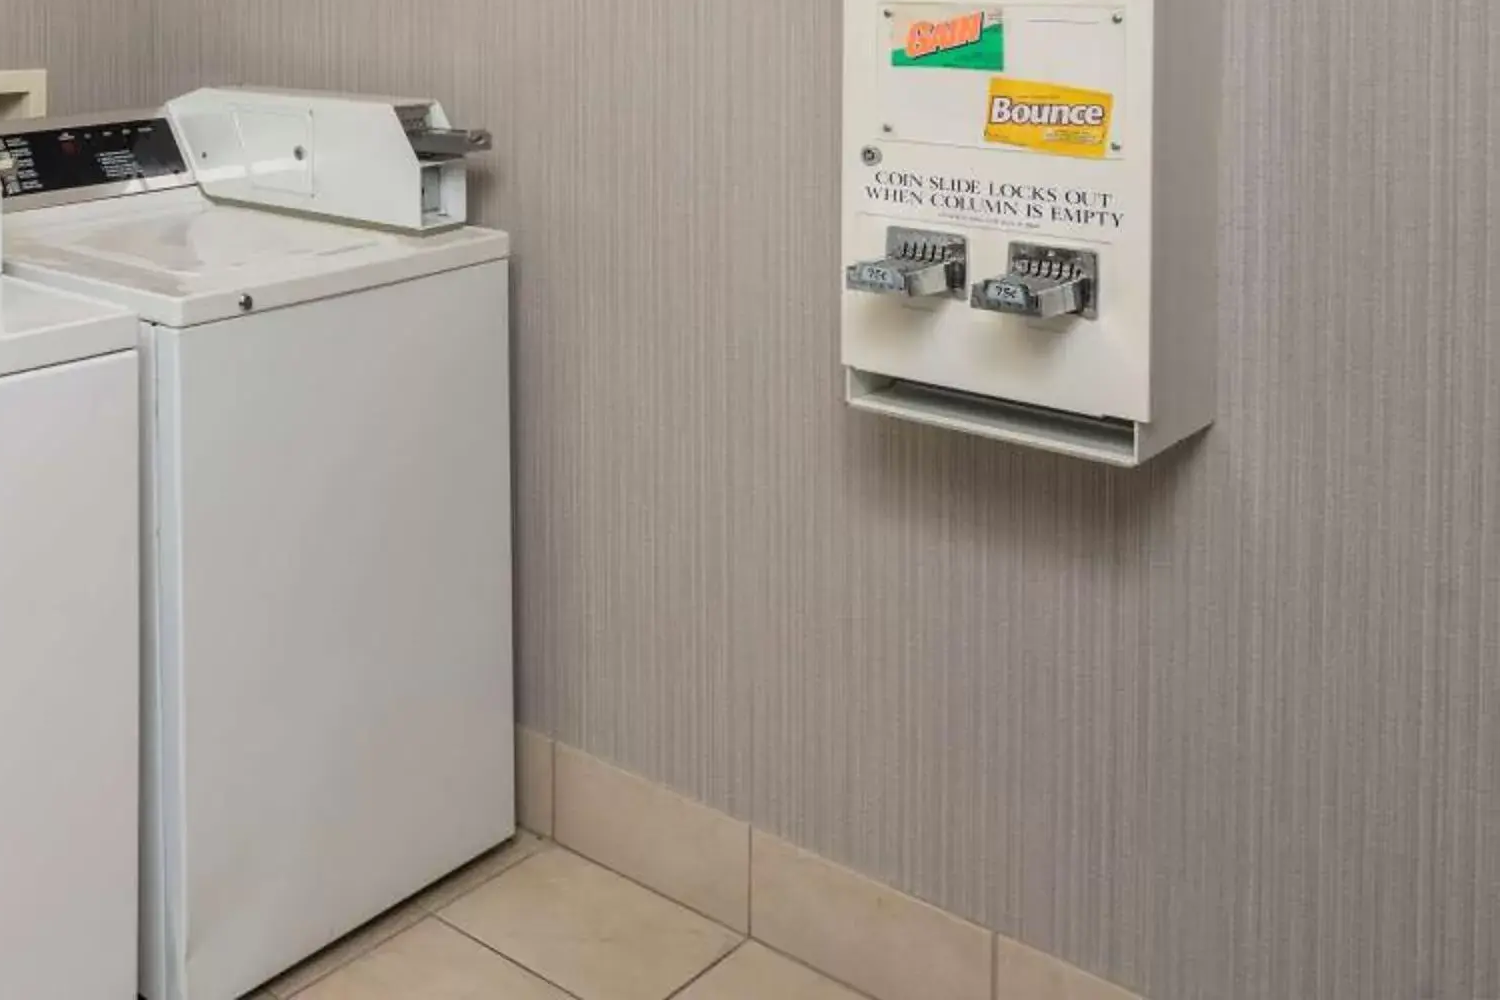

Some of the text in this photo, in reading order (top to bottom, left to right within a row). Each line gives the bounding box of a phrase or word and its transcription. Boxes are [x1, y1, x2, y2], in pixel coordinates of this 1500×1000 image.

[989, 95, 1104, 126] Bounce
[864, 186, 924, 206] WHEN
[930, 193, 1018, 216] COLUMN
[1026, 202, 1044, 219] IS
[1051, 206, 1125, 229] EMPTY
[874, 170, 1113, 209] COIN SLIDE LOCKS OUT
